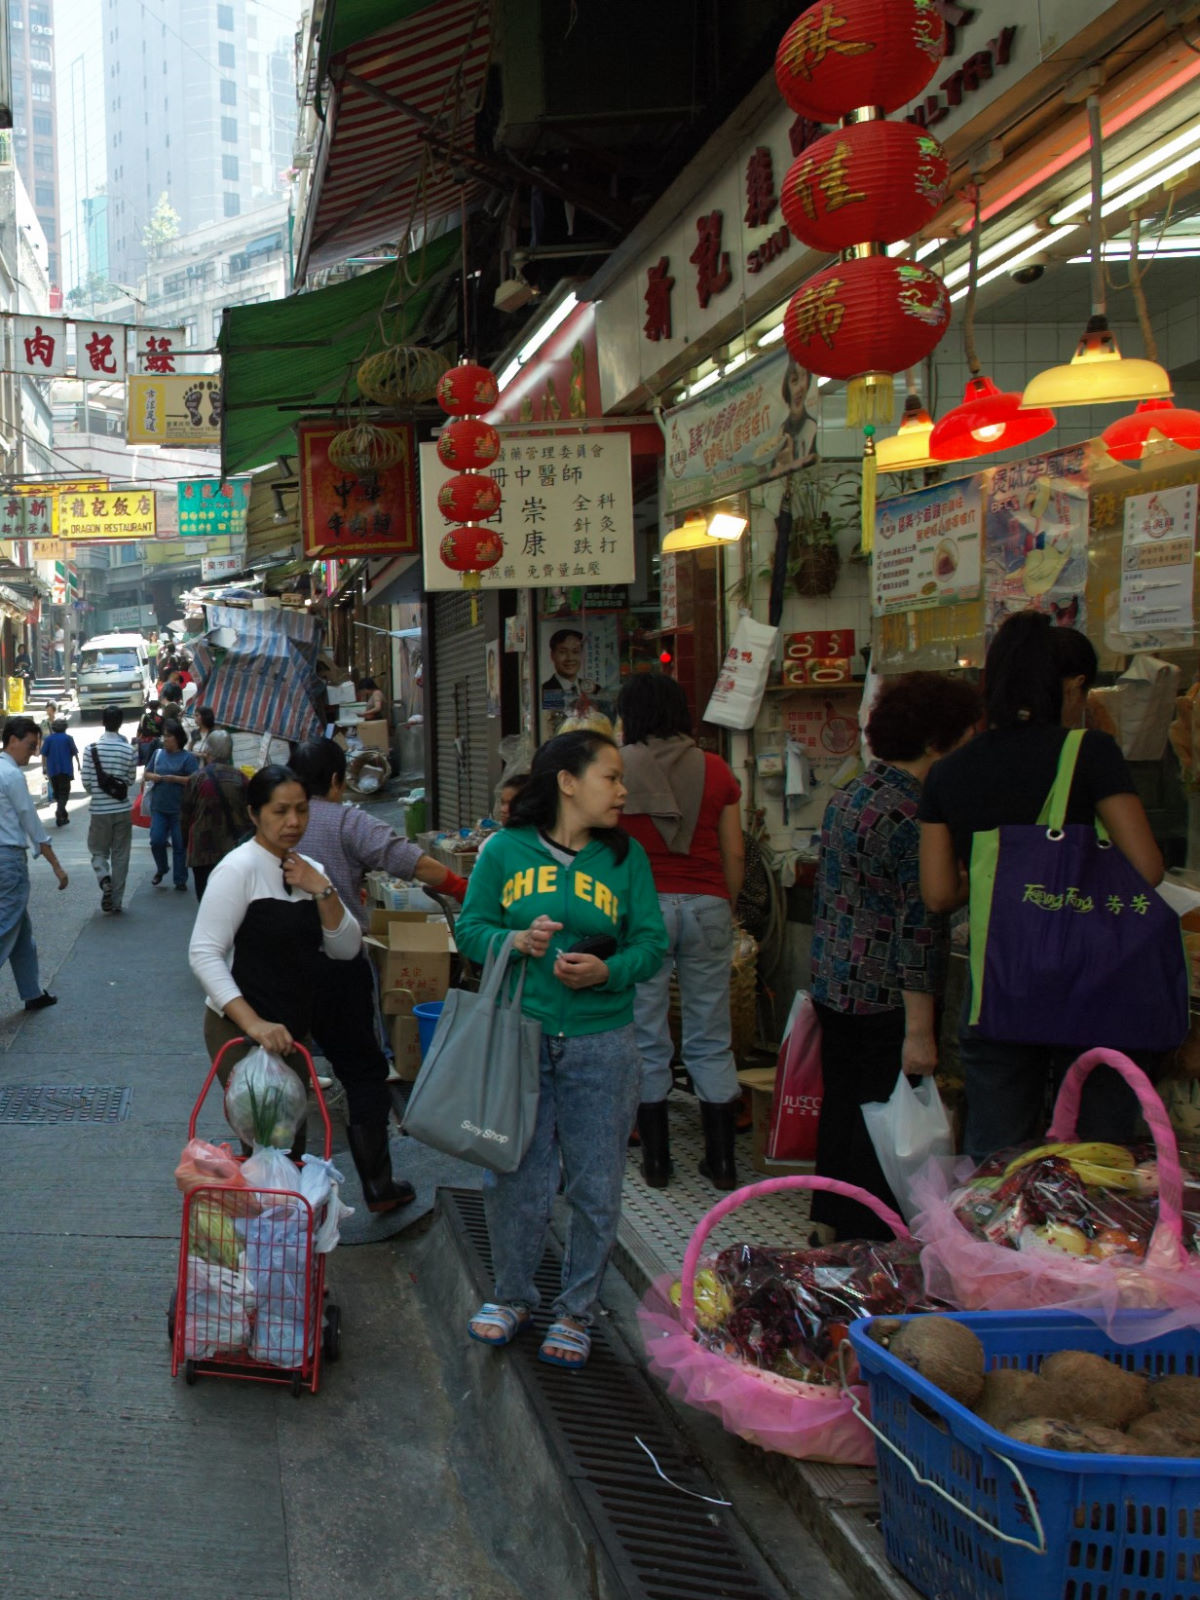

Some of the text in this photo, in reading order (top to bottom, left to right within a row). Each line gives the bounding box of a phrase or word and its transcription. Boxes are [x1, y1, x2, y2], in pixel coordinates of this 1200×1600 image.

[747, 225, 789, 273] SUN
[70, 494, 151, 518] 龍記飯店
[71, 521, 153, 535] DRAGON RESTAURANT
[783, 1095, 824, 1110] JUSCO
